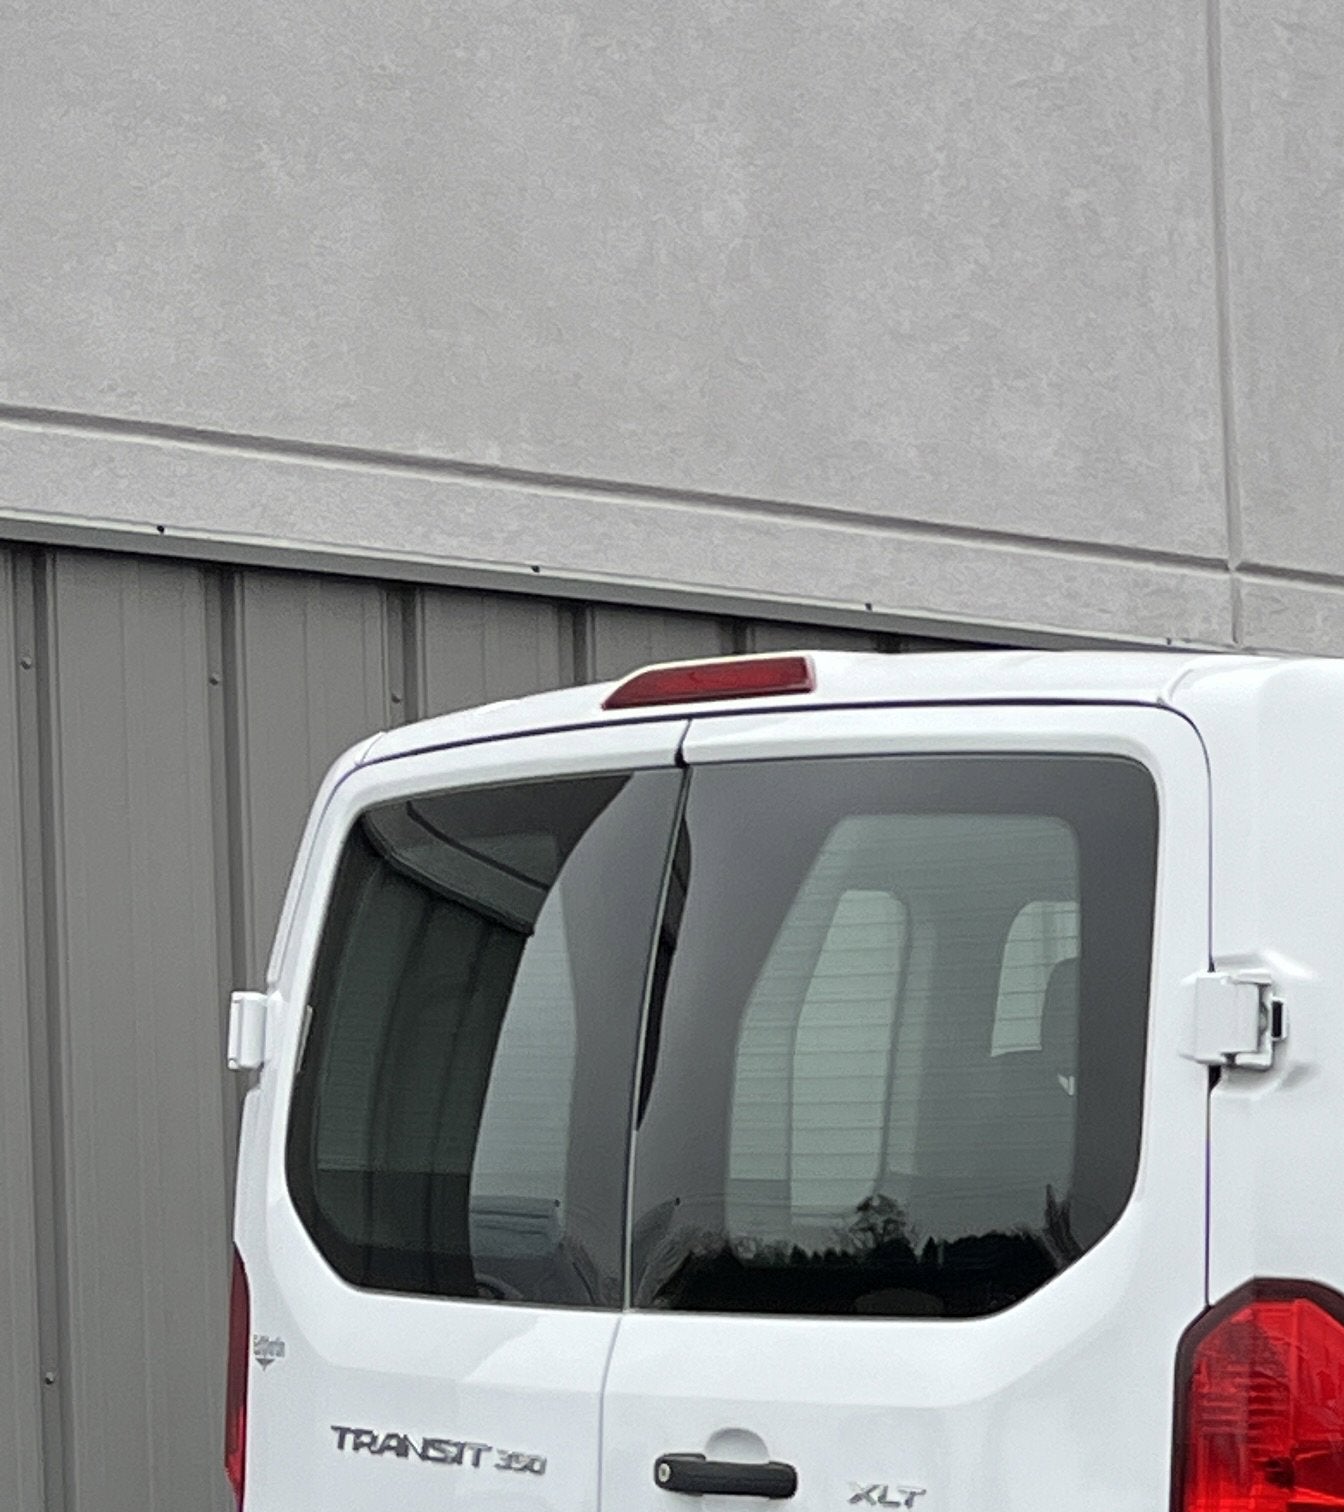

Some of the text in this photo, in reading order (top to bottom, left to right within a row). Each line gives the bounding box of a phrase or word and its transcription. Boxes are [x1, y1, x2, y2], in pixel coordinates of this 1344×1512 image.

[331, 1425, 547, 1476] TRANSIT 350
[847, 1481, 927, 1509] XLT
